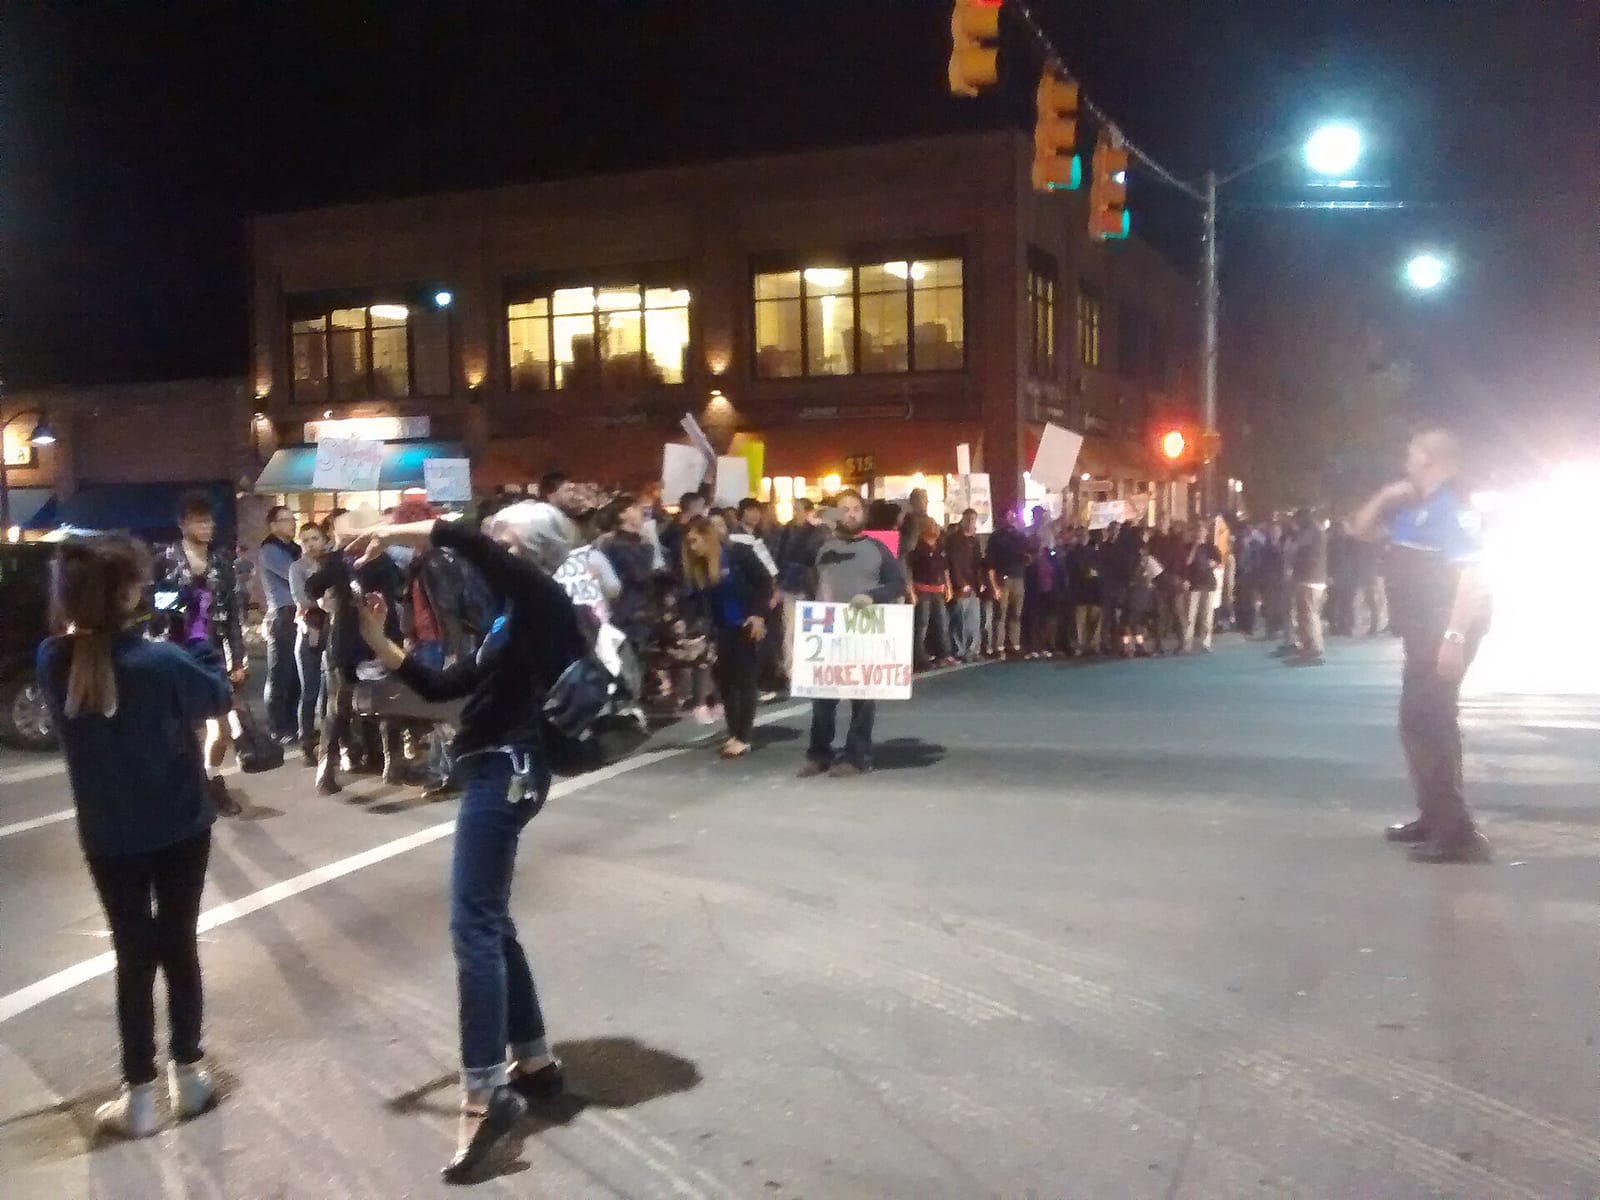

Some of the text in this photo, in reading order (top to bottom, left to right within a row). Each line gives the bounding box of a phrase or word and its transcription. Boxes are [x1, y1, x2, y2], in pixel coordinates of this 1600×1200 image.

[802, 607, 885, 634] H WON
[805, 635, 824, 661] 2
[813, 665, 859, 686] MORE
